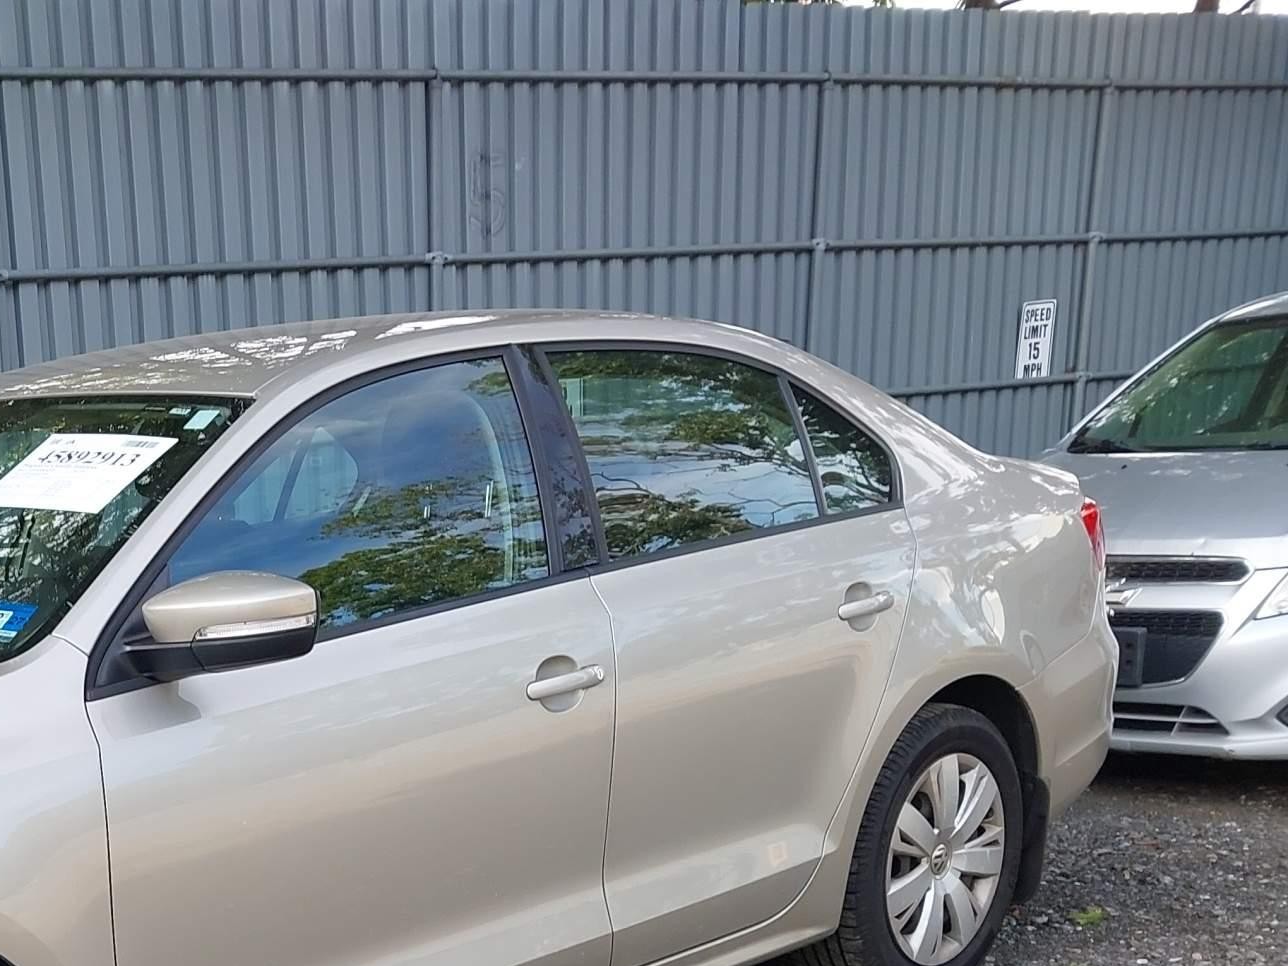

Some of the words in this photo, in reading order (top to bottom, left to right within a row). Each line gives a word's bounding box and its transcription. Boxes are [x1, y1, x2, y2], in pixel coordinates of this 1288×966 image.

[1025, 307, 1052, 323] SPEED
[1024, 324, 1048, 340] LIMIT
[1028, 342, 1040, 360] 15
[1023, 363, 1042, 378] MPH
[38, 450, 142, 467] 45892913
